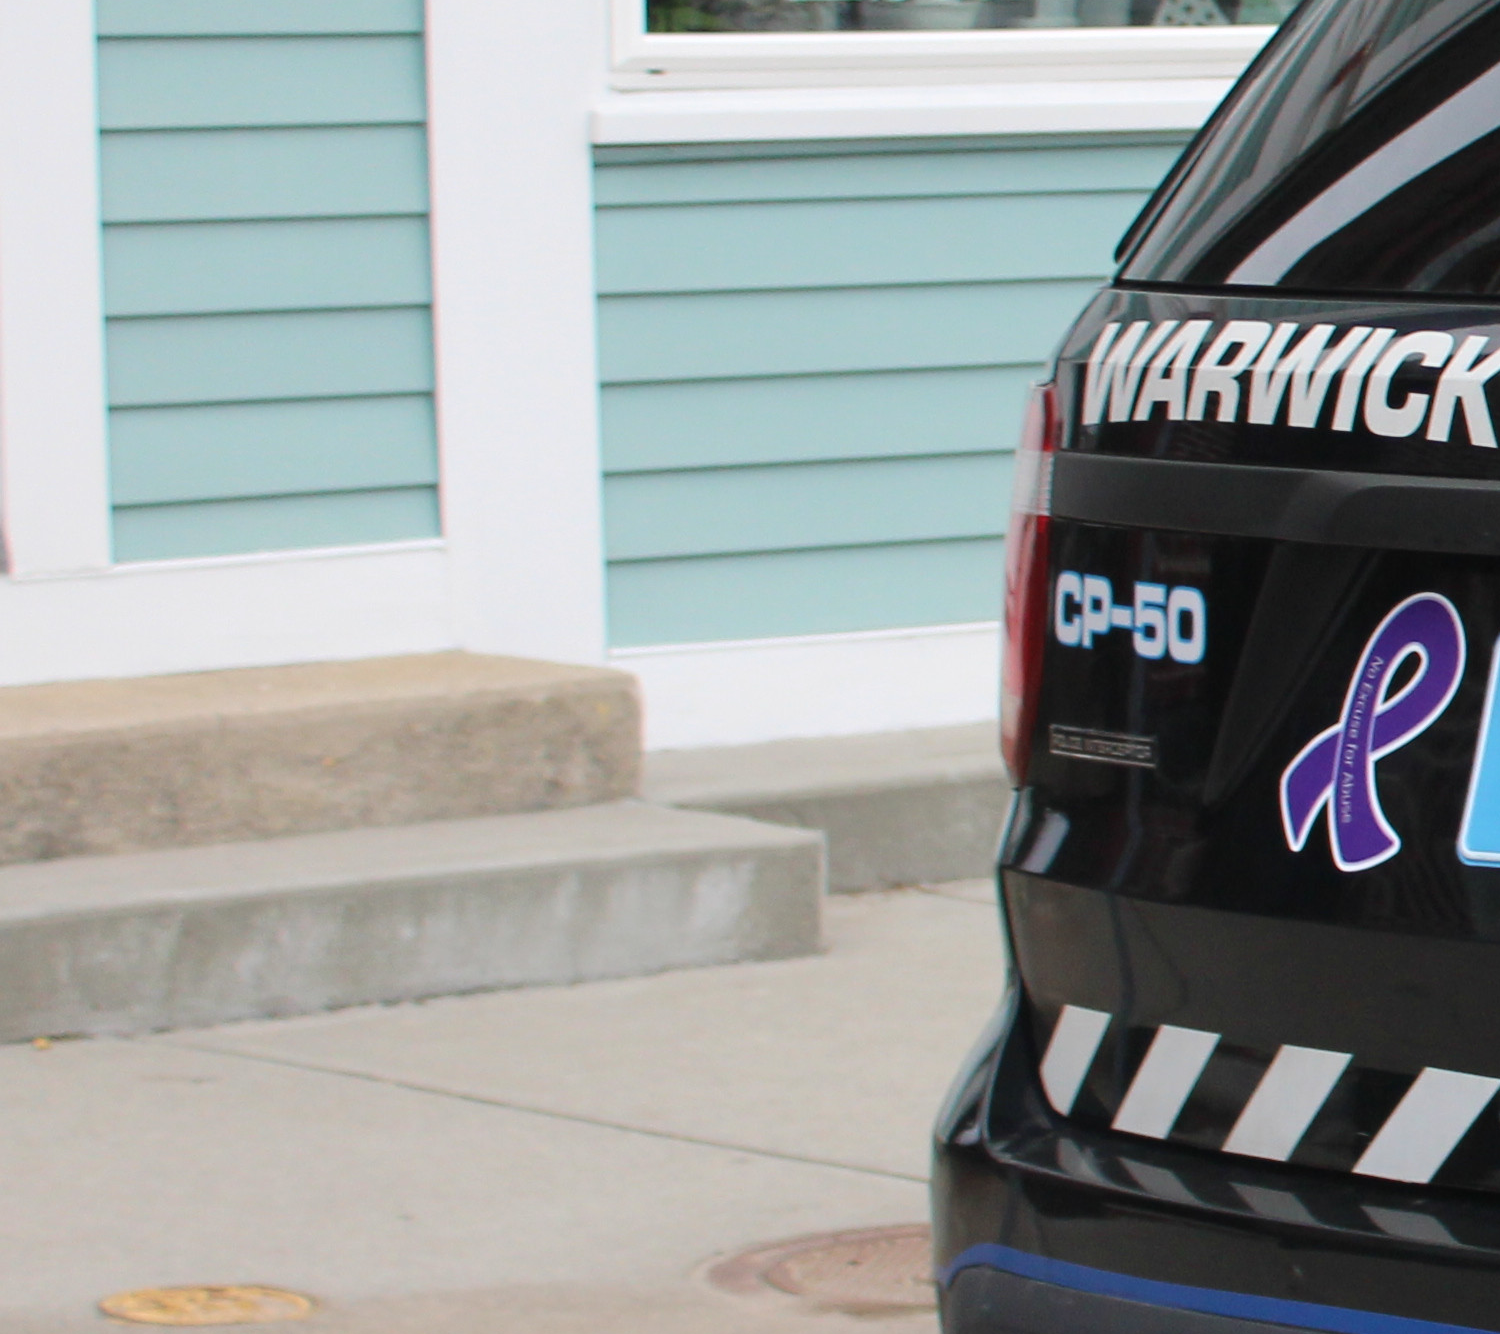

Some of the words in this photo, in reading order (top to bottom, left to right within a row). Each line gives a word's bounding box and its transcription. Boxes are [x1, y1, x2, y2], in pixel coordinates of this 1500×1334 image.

[1053, 571, 1206, 665] CP-50
[1365, 656, 1384, 679] No
[1348, 682, 1374, 738] Excuse
[1343, 743, 1358, 766] for
[1341, 771, 1354, 823] Abuse
